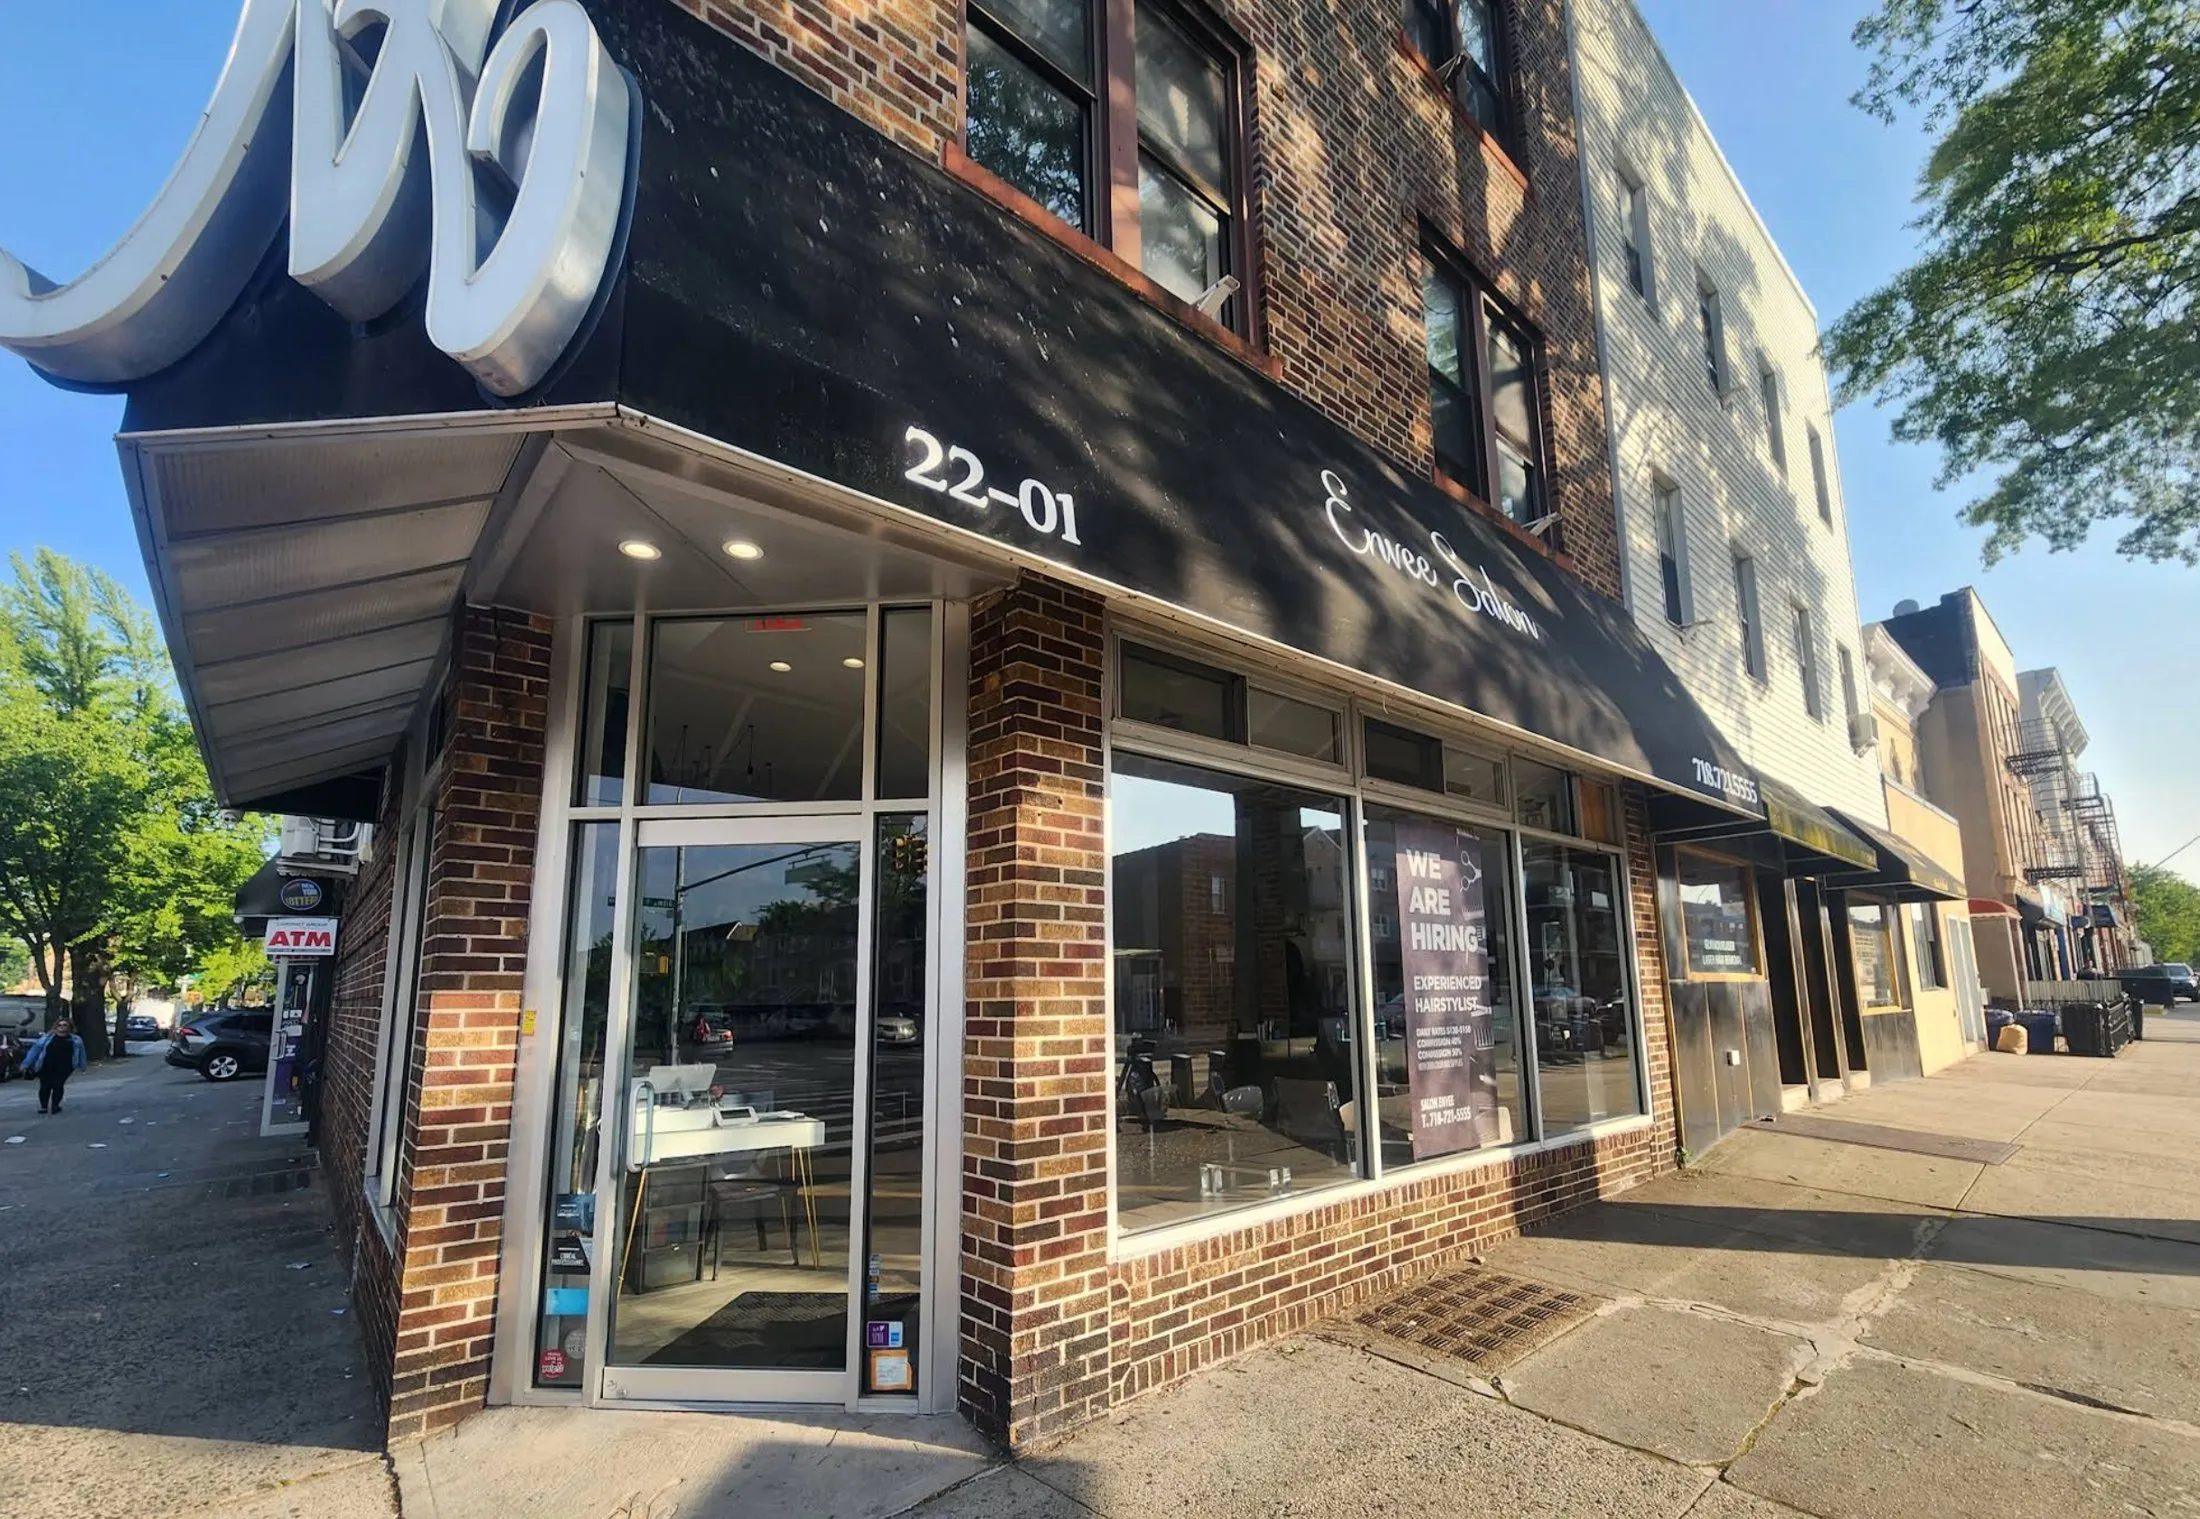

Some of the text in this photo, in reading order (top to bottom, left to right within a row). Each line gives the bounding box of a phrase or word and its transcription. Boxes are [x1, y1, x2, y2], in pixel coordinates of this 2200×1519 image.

[905, 426, 1081, 545] 22-01
[1321, 469, 1539, 640] Envee Salon
[1406, 848, 1441, 879] WE
[1409, 886, 1451, 915] ARE
[268, 931, 331, 946] ATM
[1411, 921, 1478, 952] HIRING
[1413, 975, 1482, 991] EXPERIENCED
[1415, 996, 1478, 1013] HAIRSTYLIST
